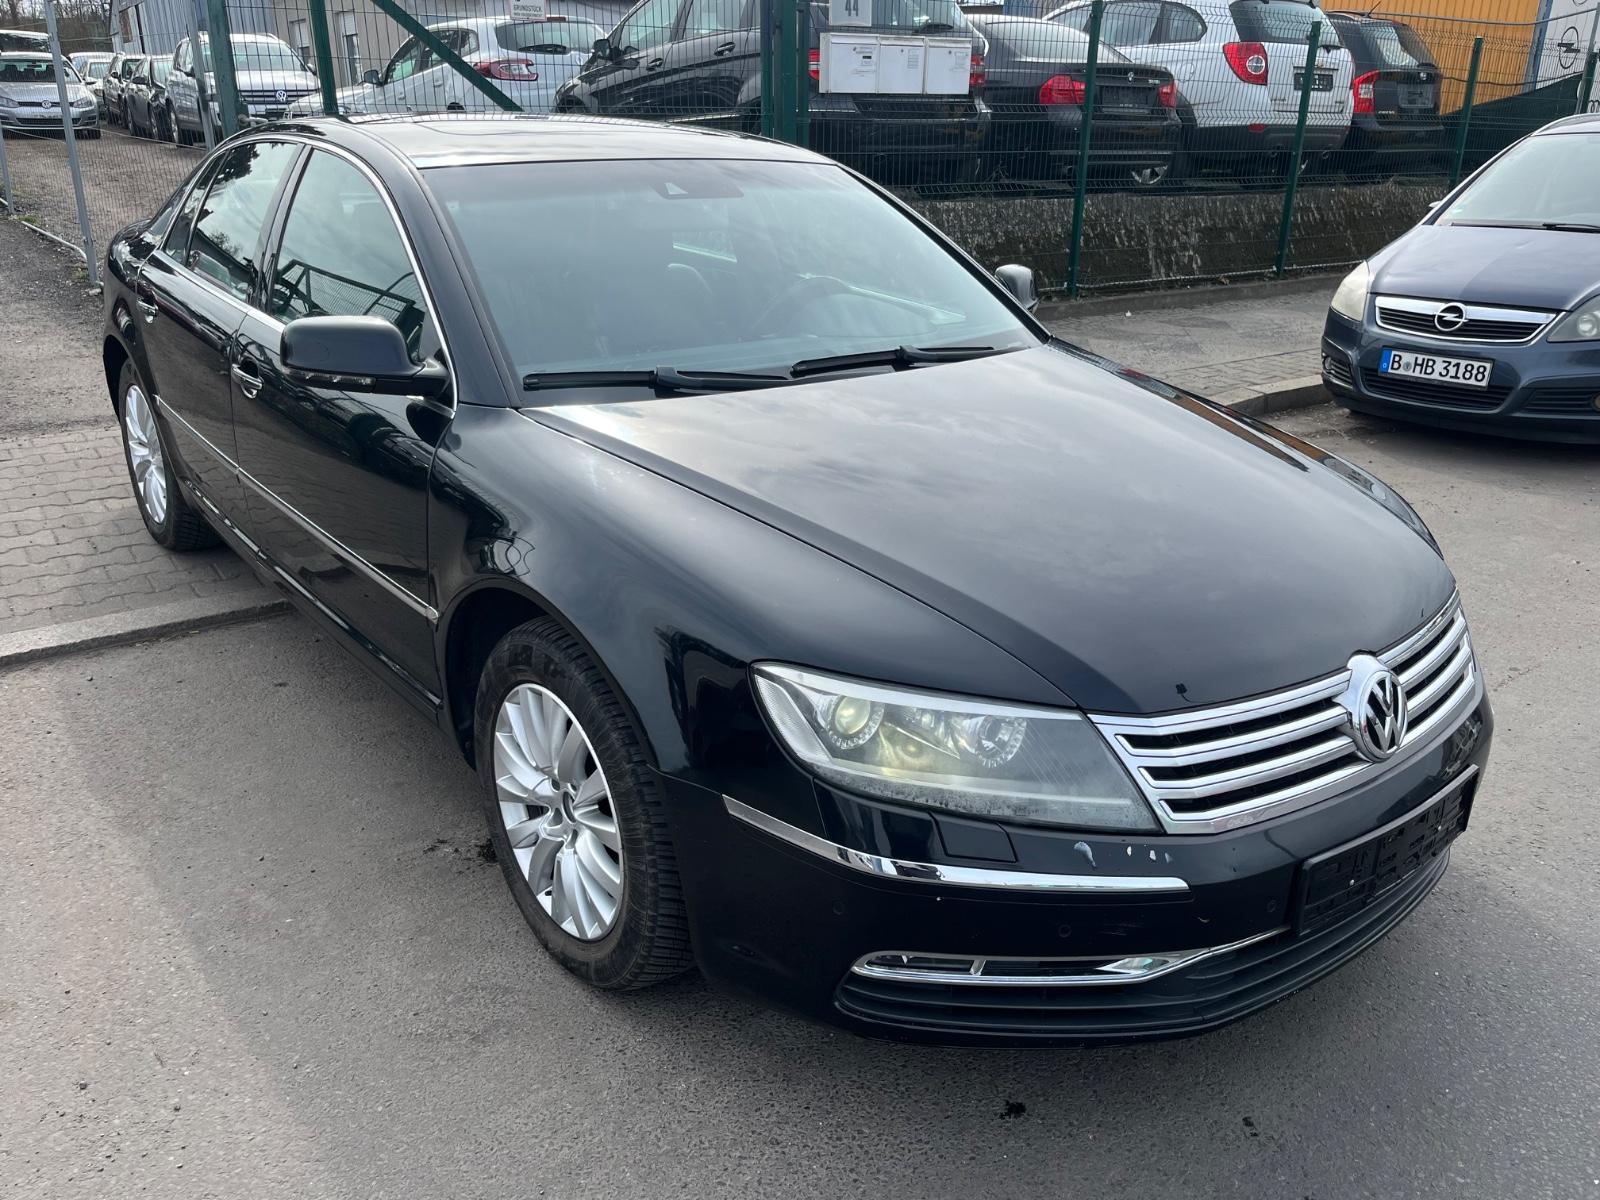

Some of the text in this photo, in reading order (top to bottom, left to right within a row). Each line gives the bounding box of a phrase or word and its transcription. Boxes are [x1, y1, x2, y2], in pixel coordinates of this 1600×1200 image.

[845, 0, 859, 17] 44
[1391, 354, 1487, 383] B HB 3188
